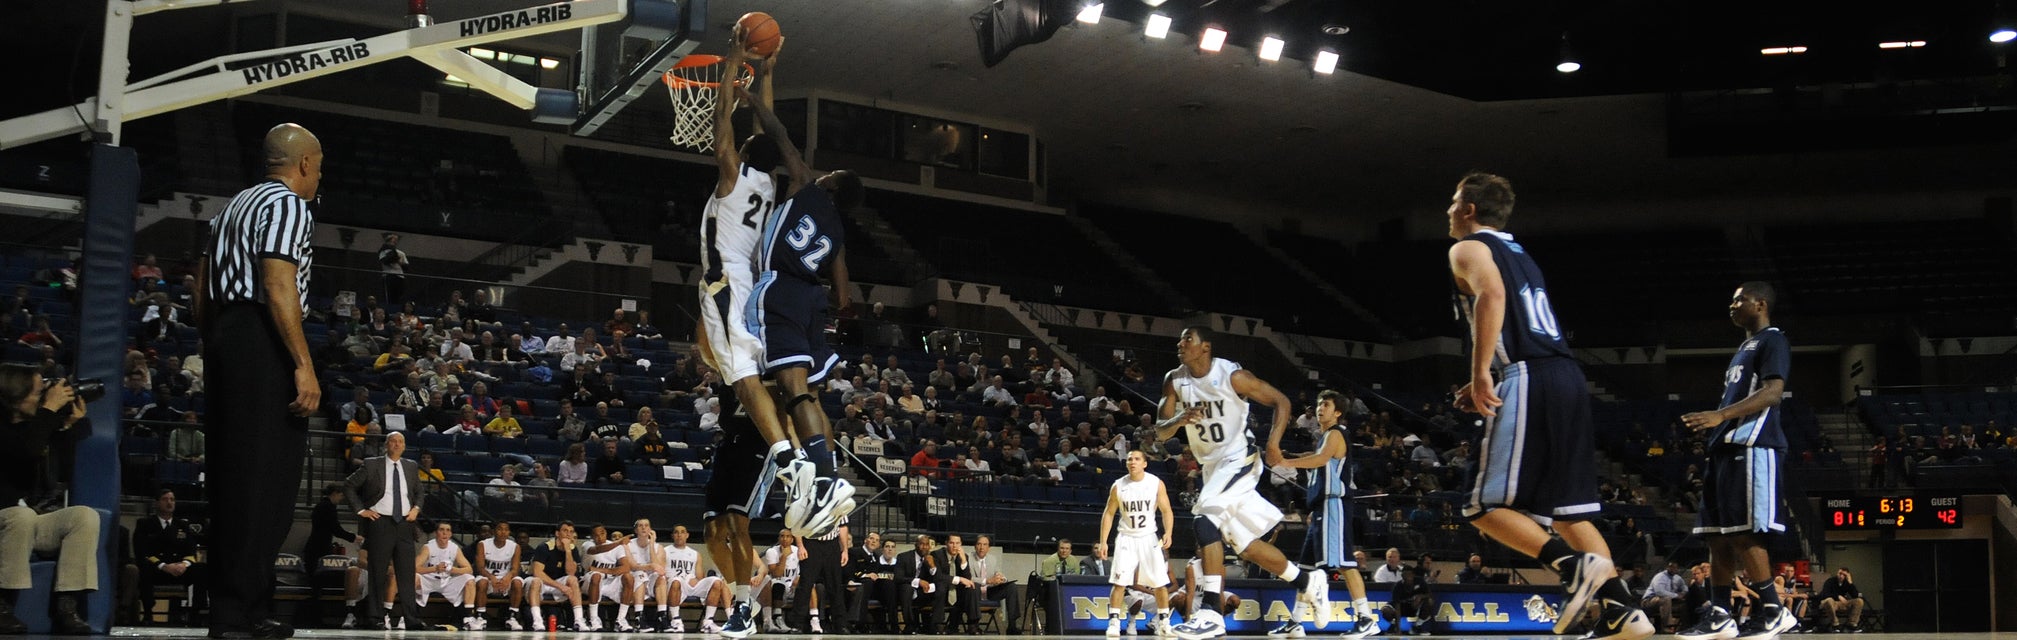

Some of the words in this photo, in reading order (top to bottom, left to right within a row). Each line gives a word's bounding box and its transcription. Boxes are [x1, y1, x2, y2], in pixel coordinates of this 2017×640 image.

[459, 4, 572, 37] HYDRA-RIB
[243, 42, 370, 85] HYDRA-RIB
[742, 193, 772, 233] 21
[785, 214, 833, 272] 32
[1519, 282, 1561, 340] 10
[1195, 422, 1225, 443] 20
[1122, 500, 1151, 512] NAVY
[1827, 499, 1851, 508] HOME
[1879, 497, 1914, 514] 6:13
[1931, 497, 1958, 507] GUEST
[1130, 515, 1147, 528] 12
[1833, 510, 1854, 526] 81
[1896, 515, 1906, 527] 2
[1937, 509, 1958, 525] 42
[485, 560, 510, 570] NAVY
[670, 560, 695, 570] NAVY
